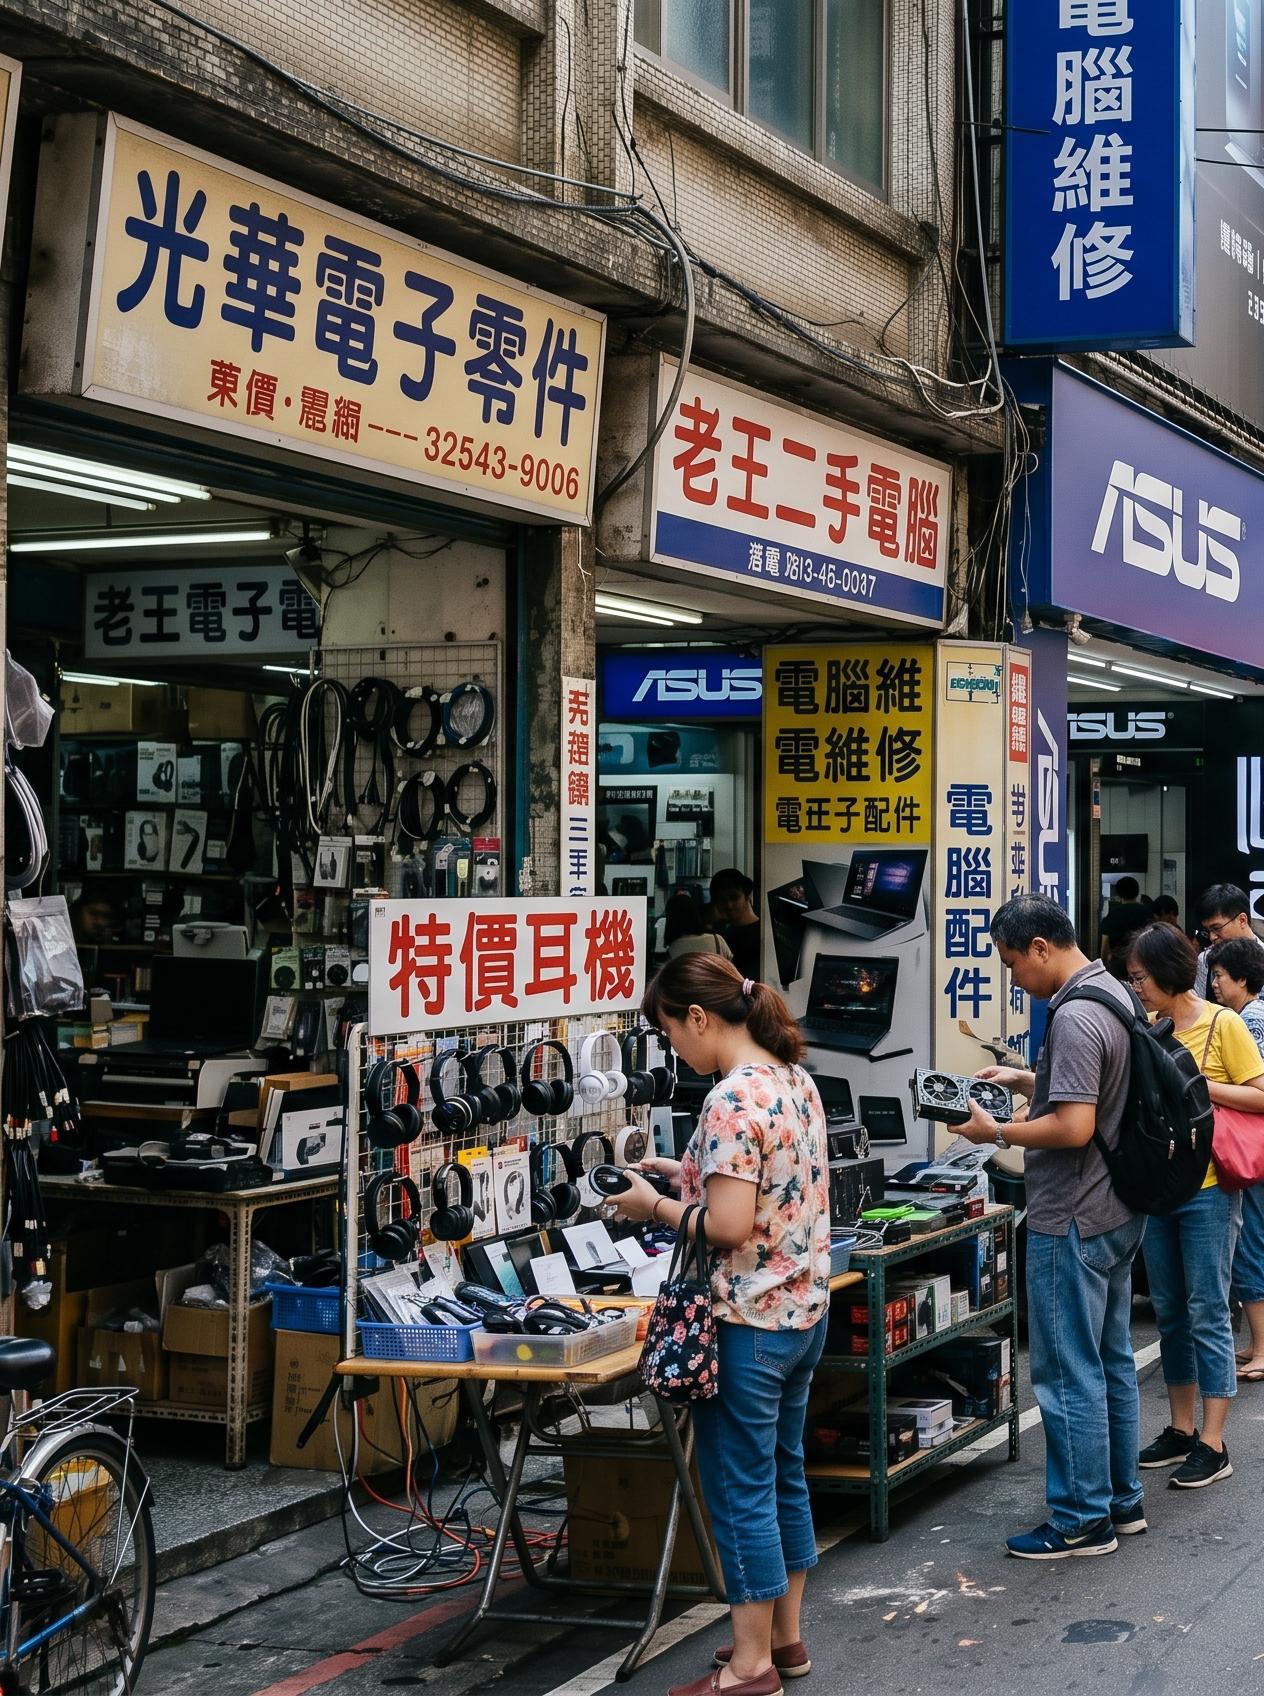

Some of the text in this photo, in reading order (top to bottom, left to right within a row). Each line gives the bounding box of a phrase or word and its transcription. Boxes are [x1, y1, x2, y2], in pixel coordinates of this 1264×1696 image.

[116, 170, 589, 447] 光華電子零件
[673, 396, 940, 571] 老王二手電腦
[1091, 459, 1242, 603] ASUS
[94, 579, 319, 646] 老王電子電
[632, 668, 763, 702] ASUS
[774, 658, 922, 715] 電腦維
[774, 726, 923, 784] 電維修
[944, 783, 993, 1019] 電腦配件
[388, 909, 635, 1018] 特價耳機
